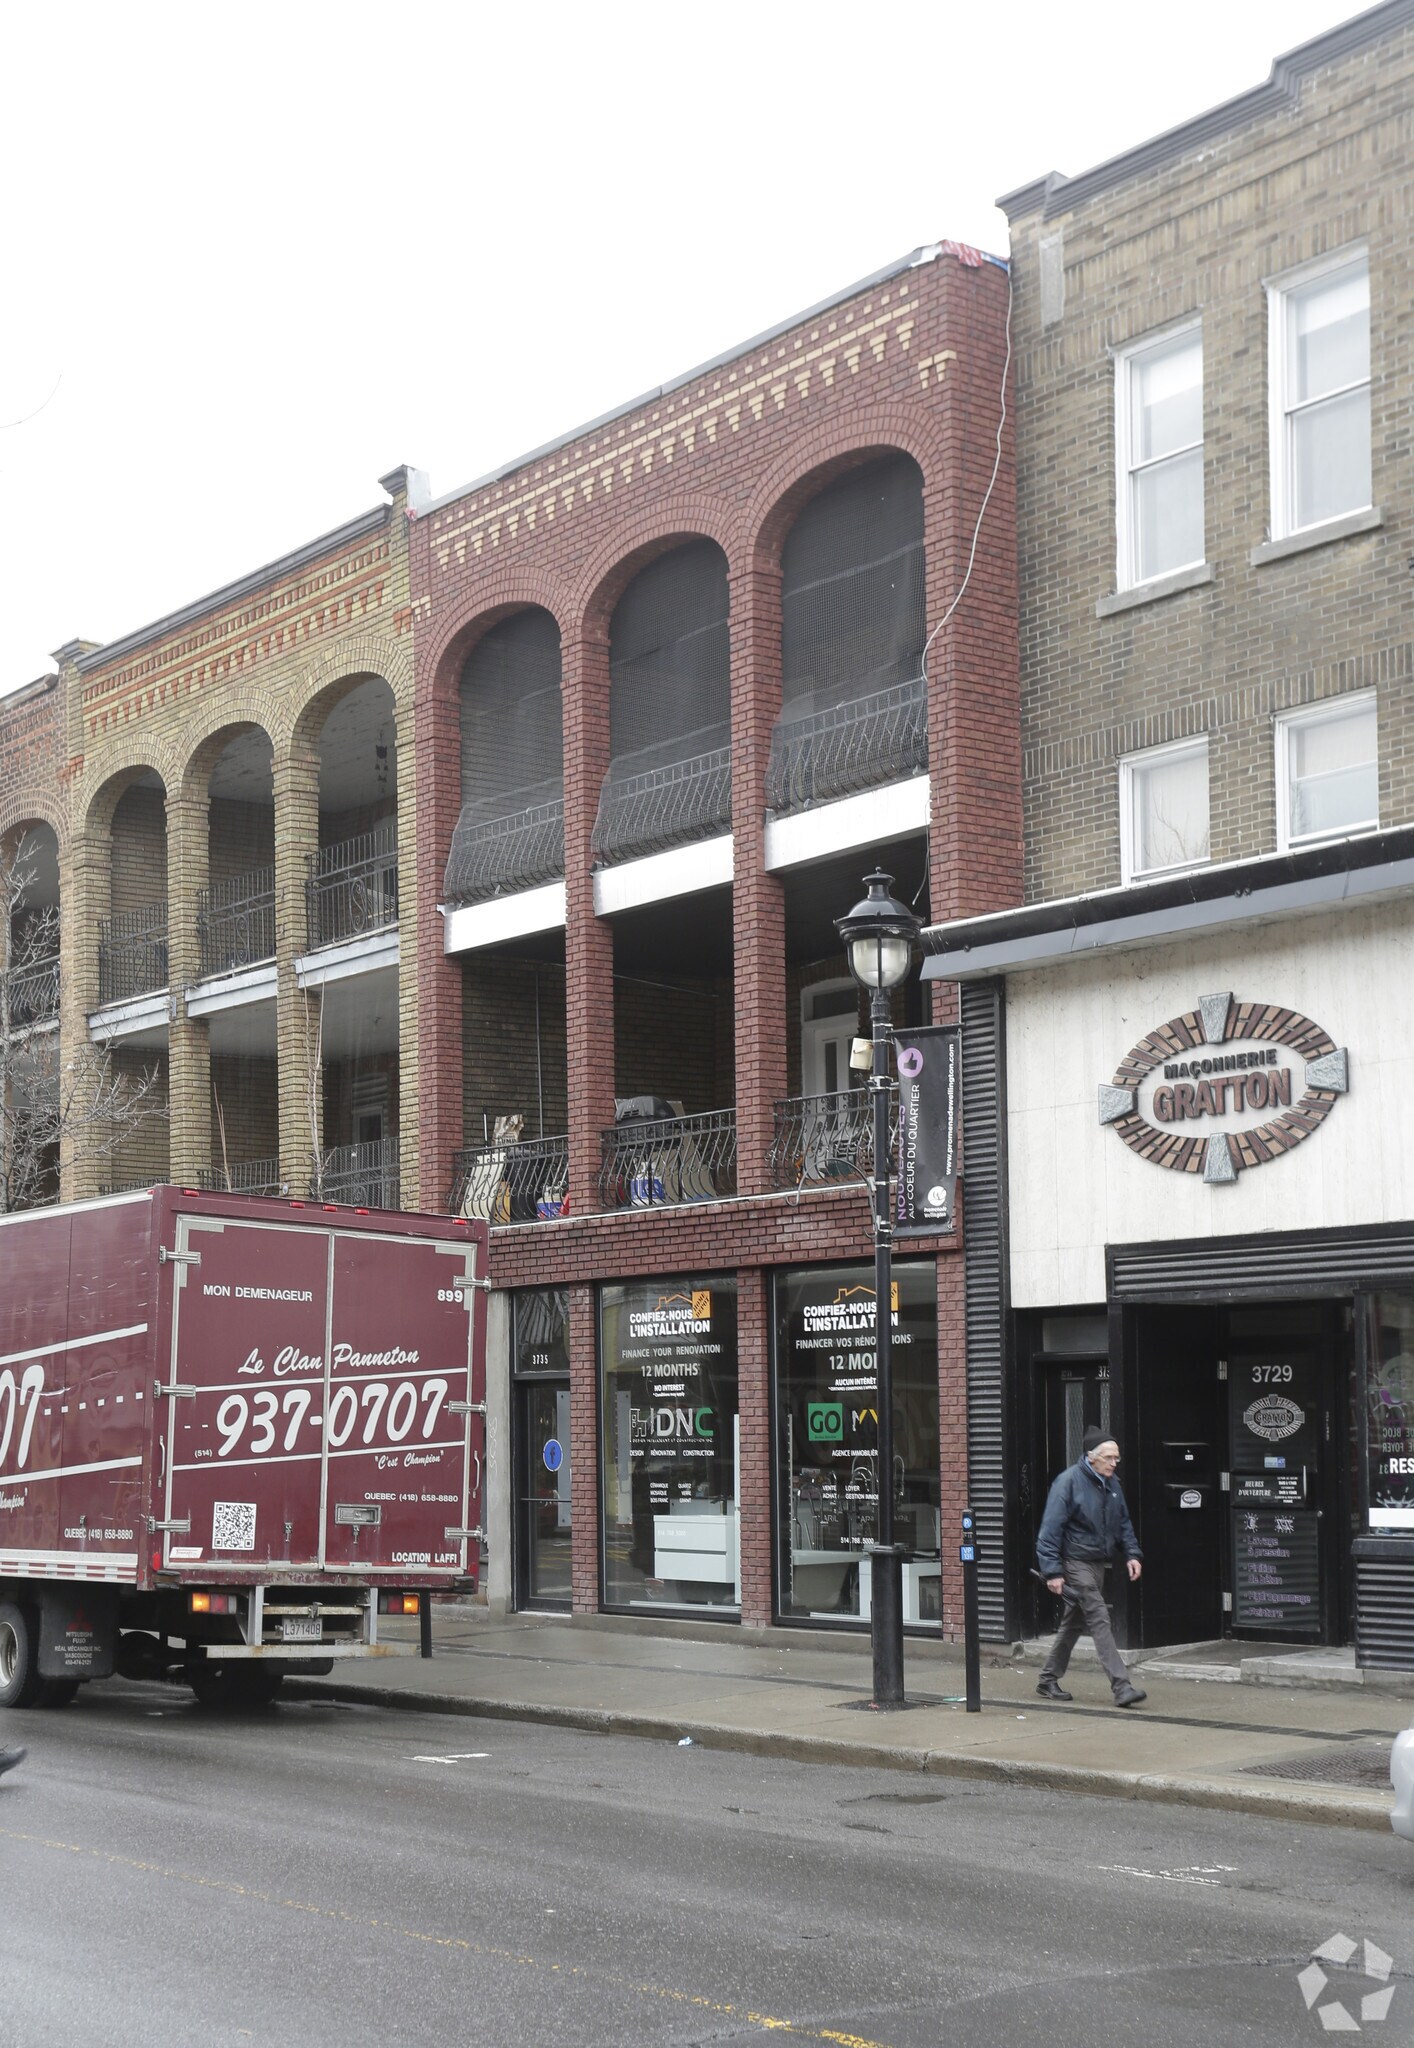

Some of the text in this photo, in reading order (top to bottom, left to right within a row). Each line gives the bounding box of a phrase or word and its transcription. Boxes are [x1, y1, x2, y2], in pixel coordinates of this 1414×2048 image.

[1164, 1049, 1277, 1079] MAÇONNERIE
[1153, 1068, 1292, 1122] GRATTON
[946, 1044, 954, 1176] www.promenadewellington.com
[907, 1084, 920, 1219] AU COEUR DU QUARTIER
[203, 1284, 312, 1302] MON DEMENAGEUR
[437, 1289, 463, 1303] 899
[630, 1309, 693, 1323] CONFIEZ-NOUS
[804, 1302, 877, 1317] CONFIEZ-NOUS
[630, 1320, 710, 1338] L'INSTALLATION
[804, 1312, 898, 1332] L'INSTALLATN
[796, 1334, 912, 1349] FINANCER VOS RÉNOIONS
[237, 1343, 419, 1376] Le Clan Panneton
[532, 1354, 548, 1365] 3735
[622, 1344, 720, 1358] FINANCE YOUR RENOVATION
[829, 1352, 877, 1370] 12 MOI
[641, 1365, 652, 1377] 12
[1252, 1365, 1292, 1382] 3729
[216, 1378, 448, 1456] 937-0707
[810, 1410, 841, 1433] GO
[851, 1448, 878, 1456] IMMOBILIÈR
[1390, 1457, 1414, 1474] RES
[364, 1492, 396, 1500] QUEBEC
[399, 1494, 418, 1502] (418)
[64, 1528, 86, 1539] QUEBEC
[88, 1528, 102, 1540] (418)
[392, 1552, 457, 1563] LOCATION LAFFI
